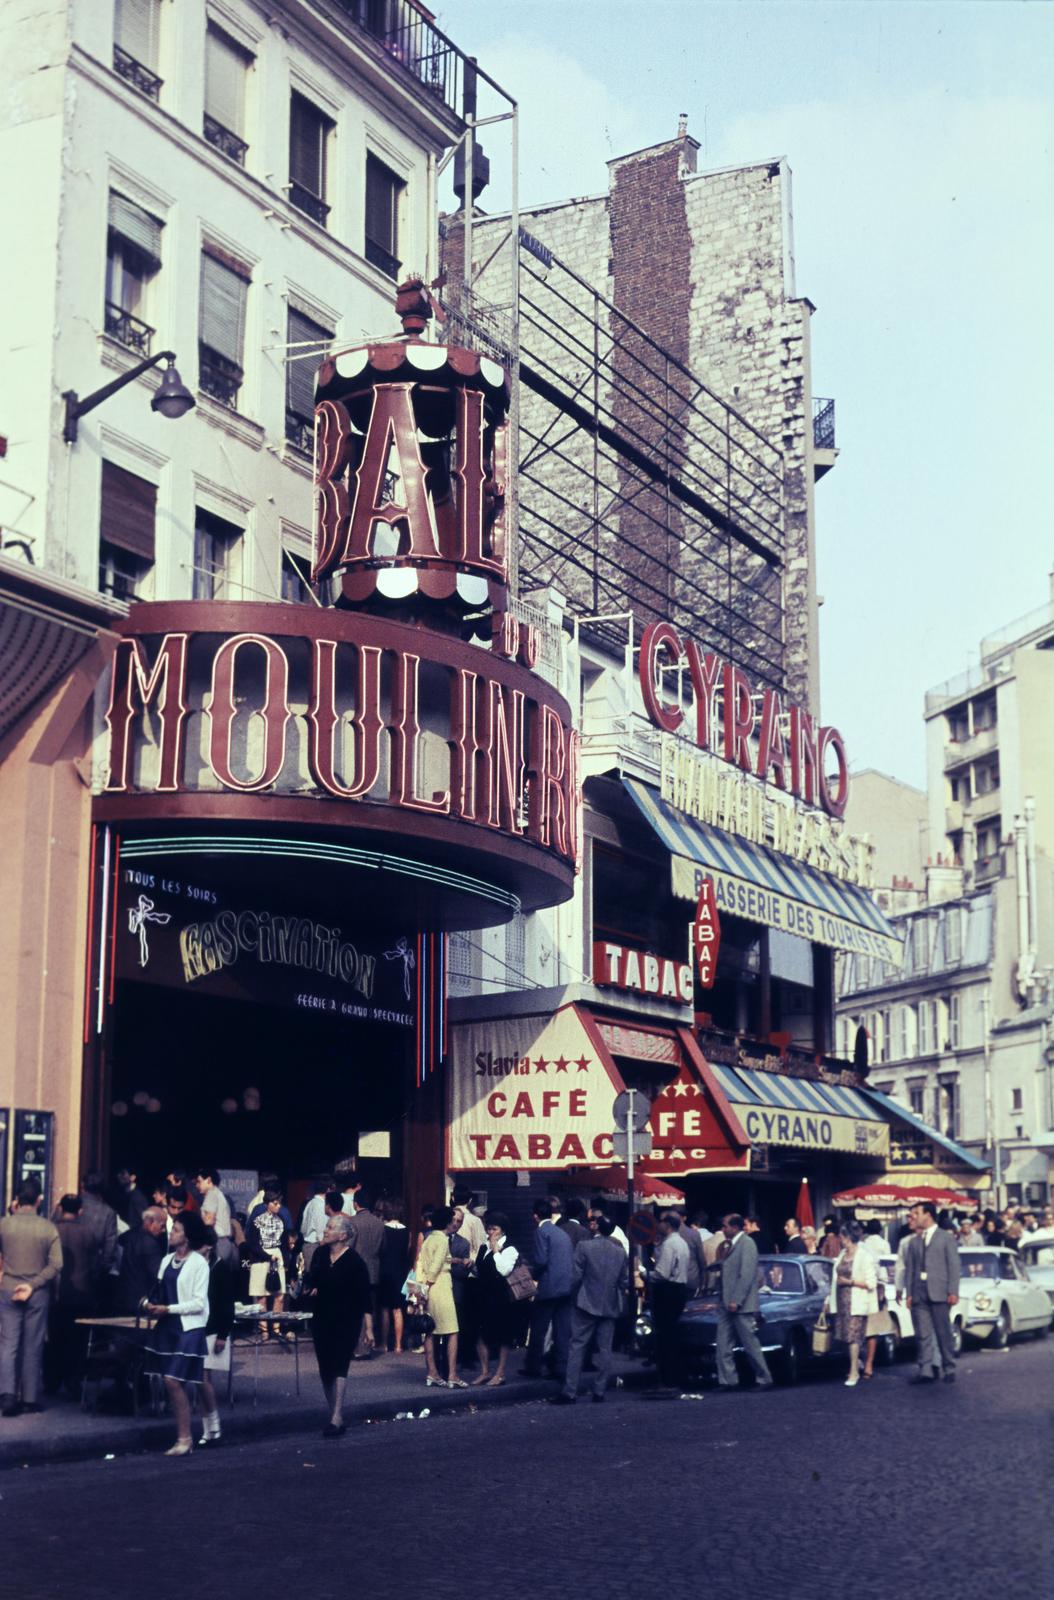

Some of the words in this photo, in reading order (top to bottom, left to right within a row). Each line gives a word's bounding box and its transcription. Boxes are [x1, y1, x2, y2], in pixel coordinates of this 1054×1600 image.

[311, 382, 507, 583] BAL
[503, 611, 542, 669] DU
[104, 632, 525, 835] MOULIN
[639, 621, 849, 818] CYRANO
[127, 869, 156, 888] TOUS
[162, 879, 181, 894] LES
[187, 885, 217, 904] SOIRS
[180, 910, 376, 1000] FASCINATION
[698, 884, 714, 982] TABAC
[787, 901, 815, 936] DES
[819, 915, 893, 961] TOURISTES
[606, 944, 693, 1001] TABAC
[475, 1051, 530, 1076] Slavia
[487, 1088, 587, 1118] CAFÉ
[746, 1111, 832, 1145] CYRANO
[469, 1133, 614, 1160] TABAC
